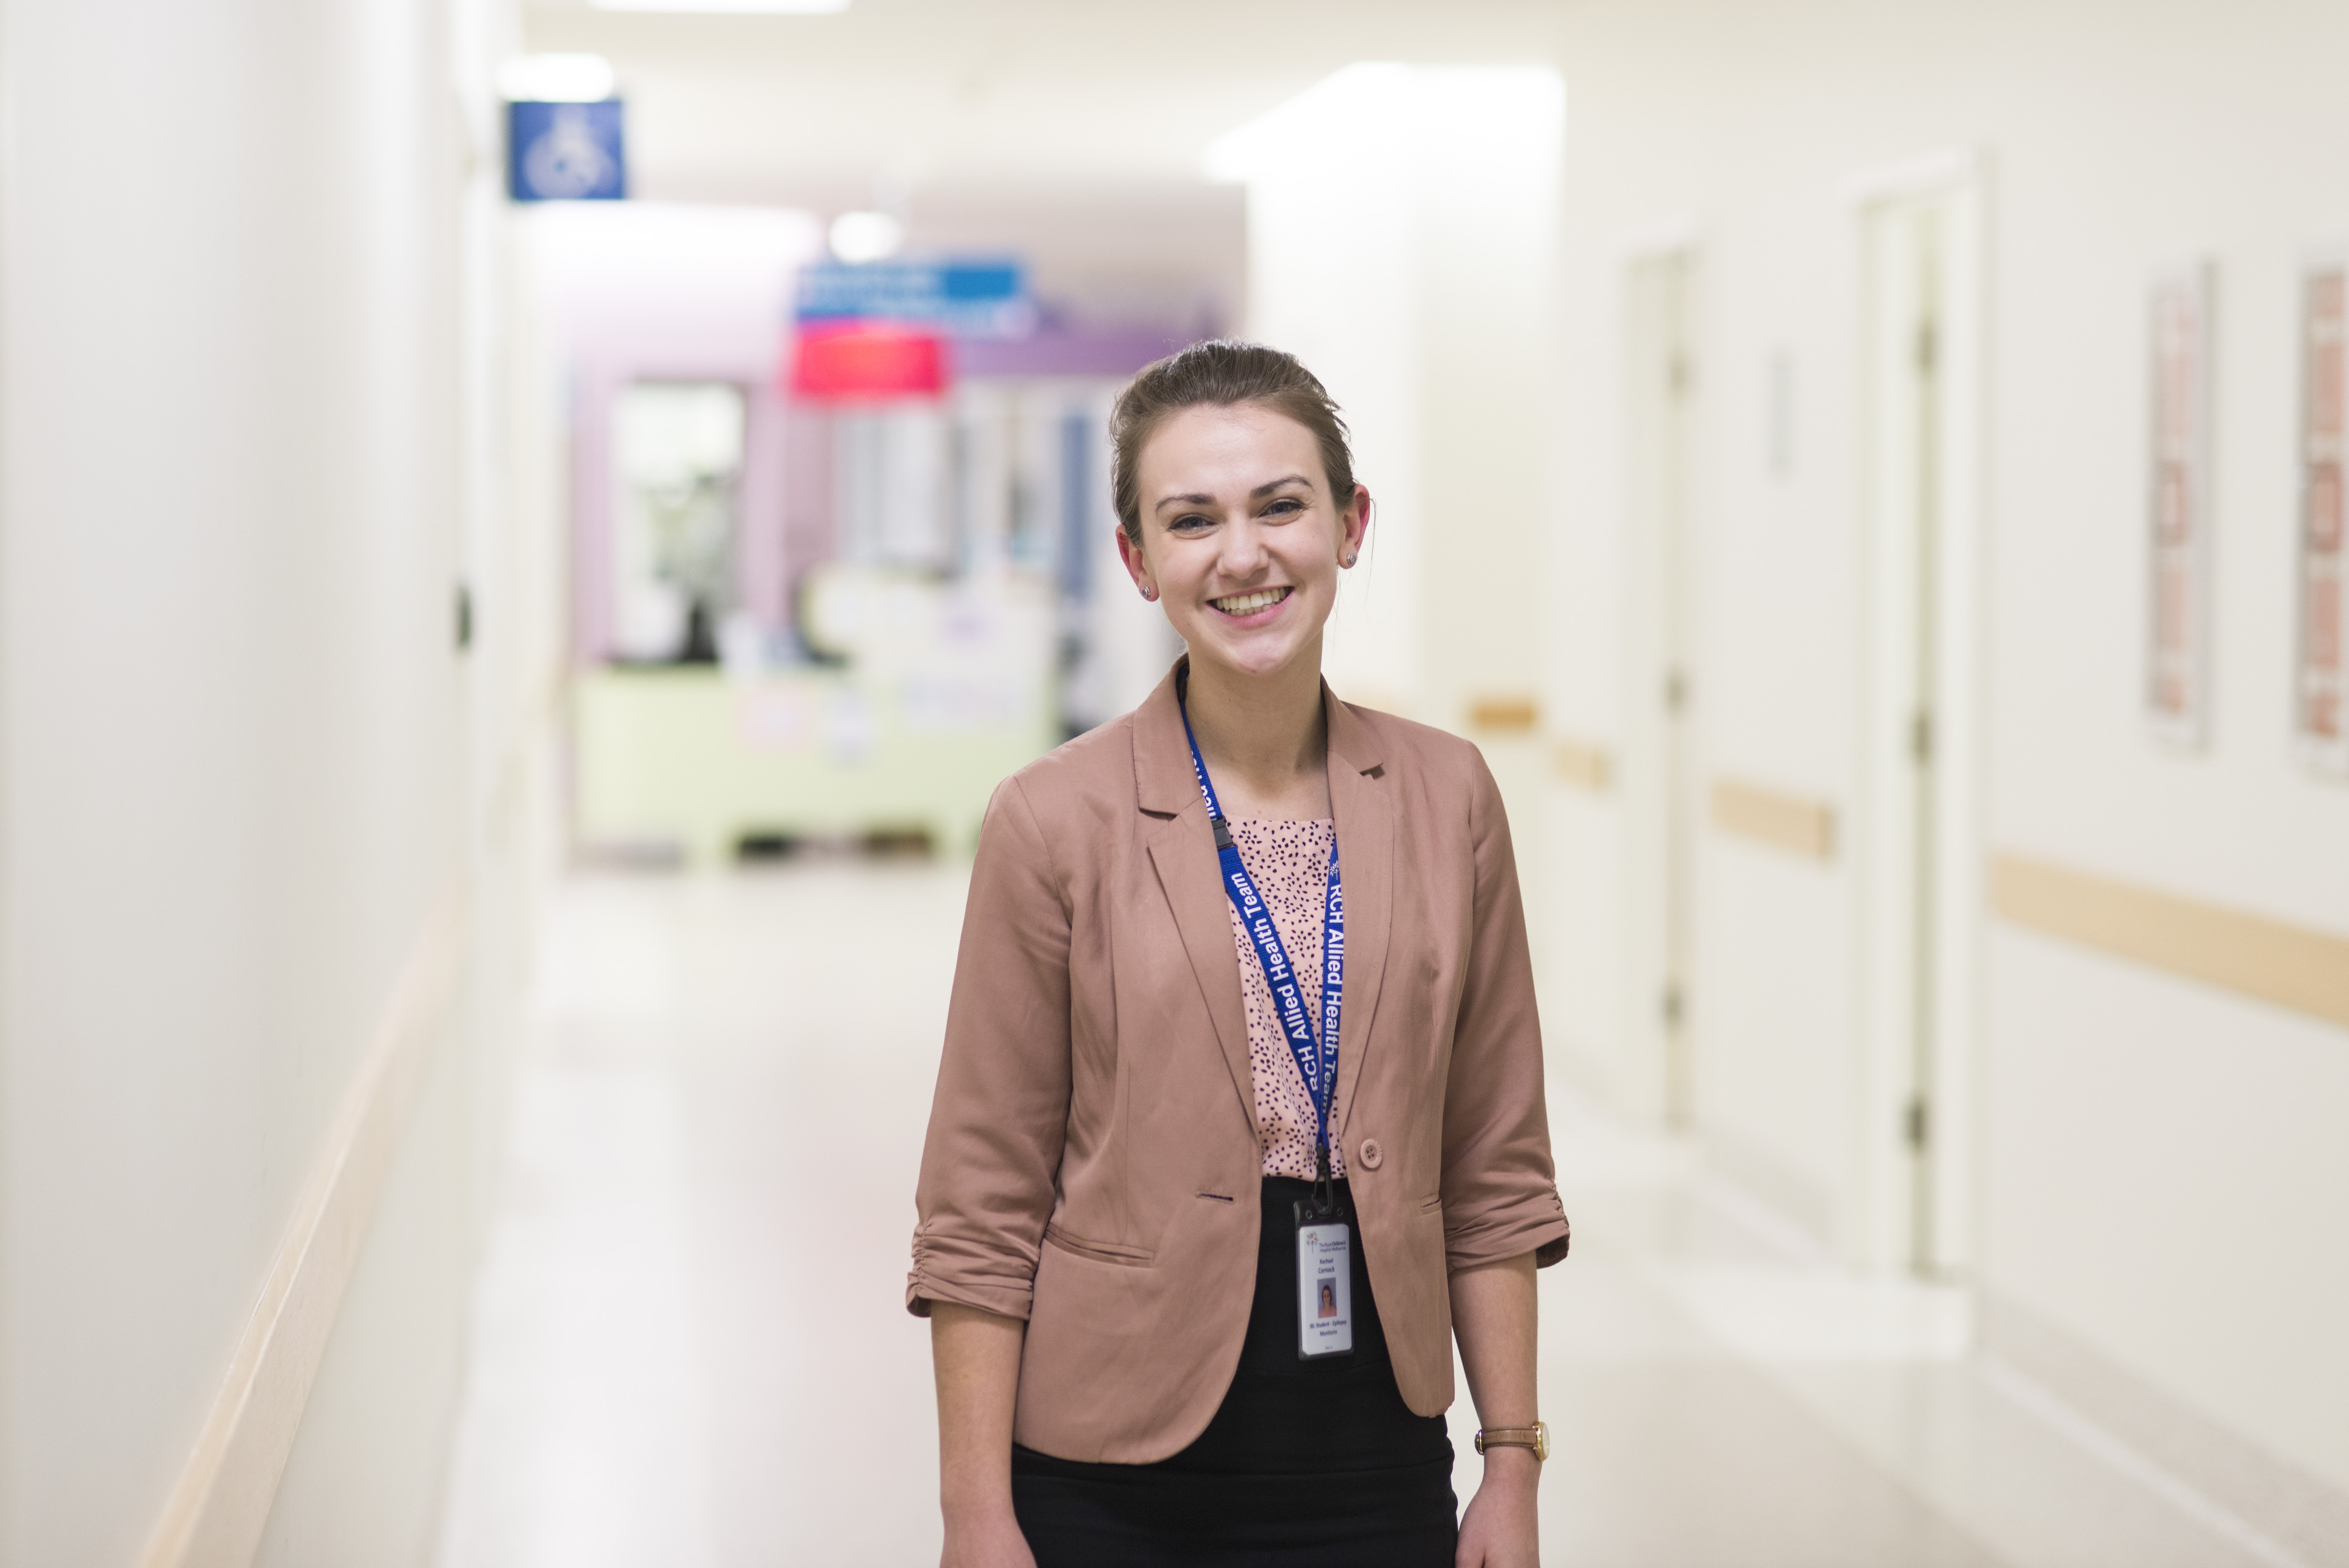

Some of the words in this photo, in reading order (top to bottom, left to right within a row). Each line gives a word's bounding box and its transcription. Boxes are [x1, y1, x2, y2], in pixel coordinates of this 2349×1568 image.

[1231, 873, 1262, 918] Team
[1330, 884, 1344, 923] RCH
[1254, 918, 1289, 981] Health
[1328, 928, 1344, 985] Allied
[1277, 983, 1310, 1039] Allied
[1325, 991, 1342, 1055] Health
[1298, 1046, 1318, 1091] RCH
[1322, 1061, 1336, 1113] Team
